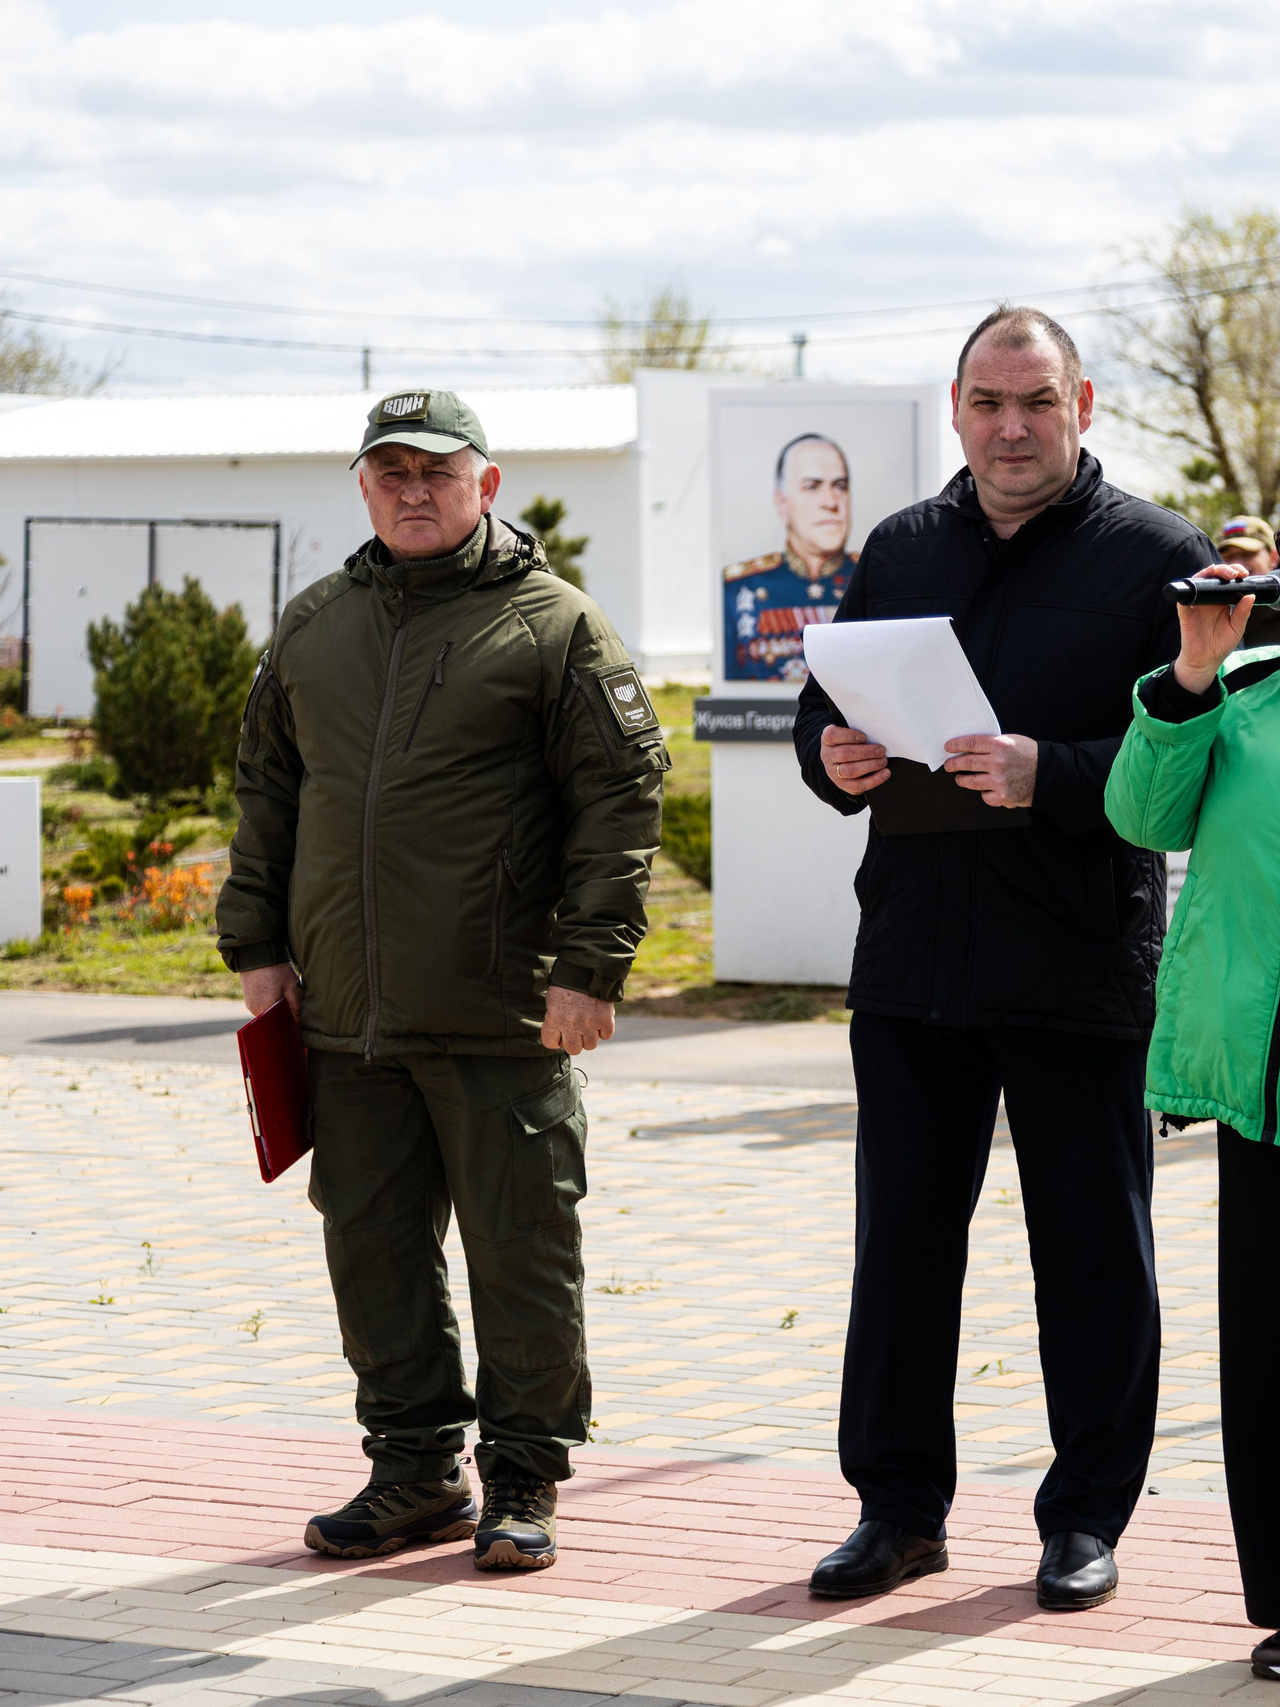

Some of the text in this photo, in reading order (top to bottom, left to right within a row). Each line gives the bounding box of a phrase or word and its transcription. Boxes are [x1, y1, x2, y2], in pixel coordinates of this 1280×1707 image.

[382, 396, 425, 417] ВОИН
[613, 682, 637, 703] ВОИН
[694, 710, 745, 734] Жуков
